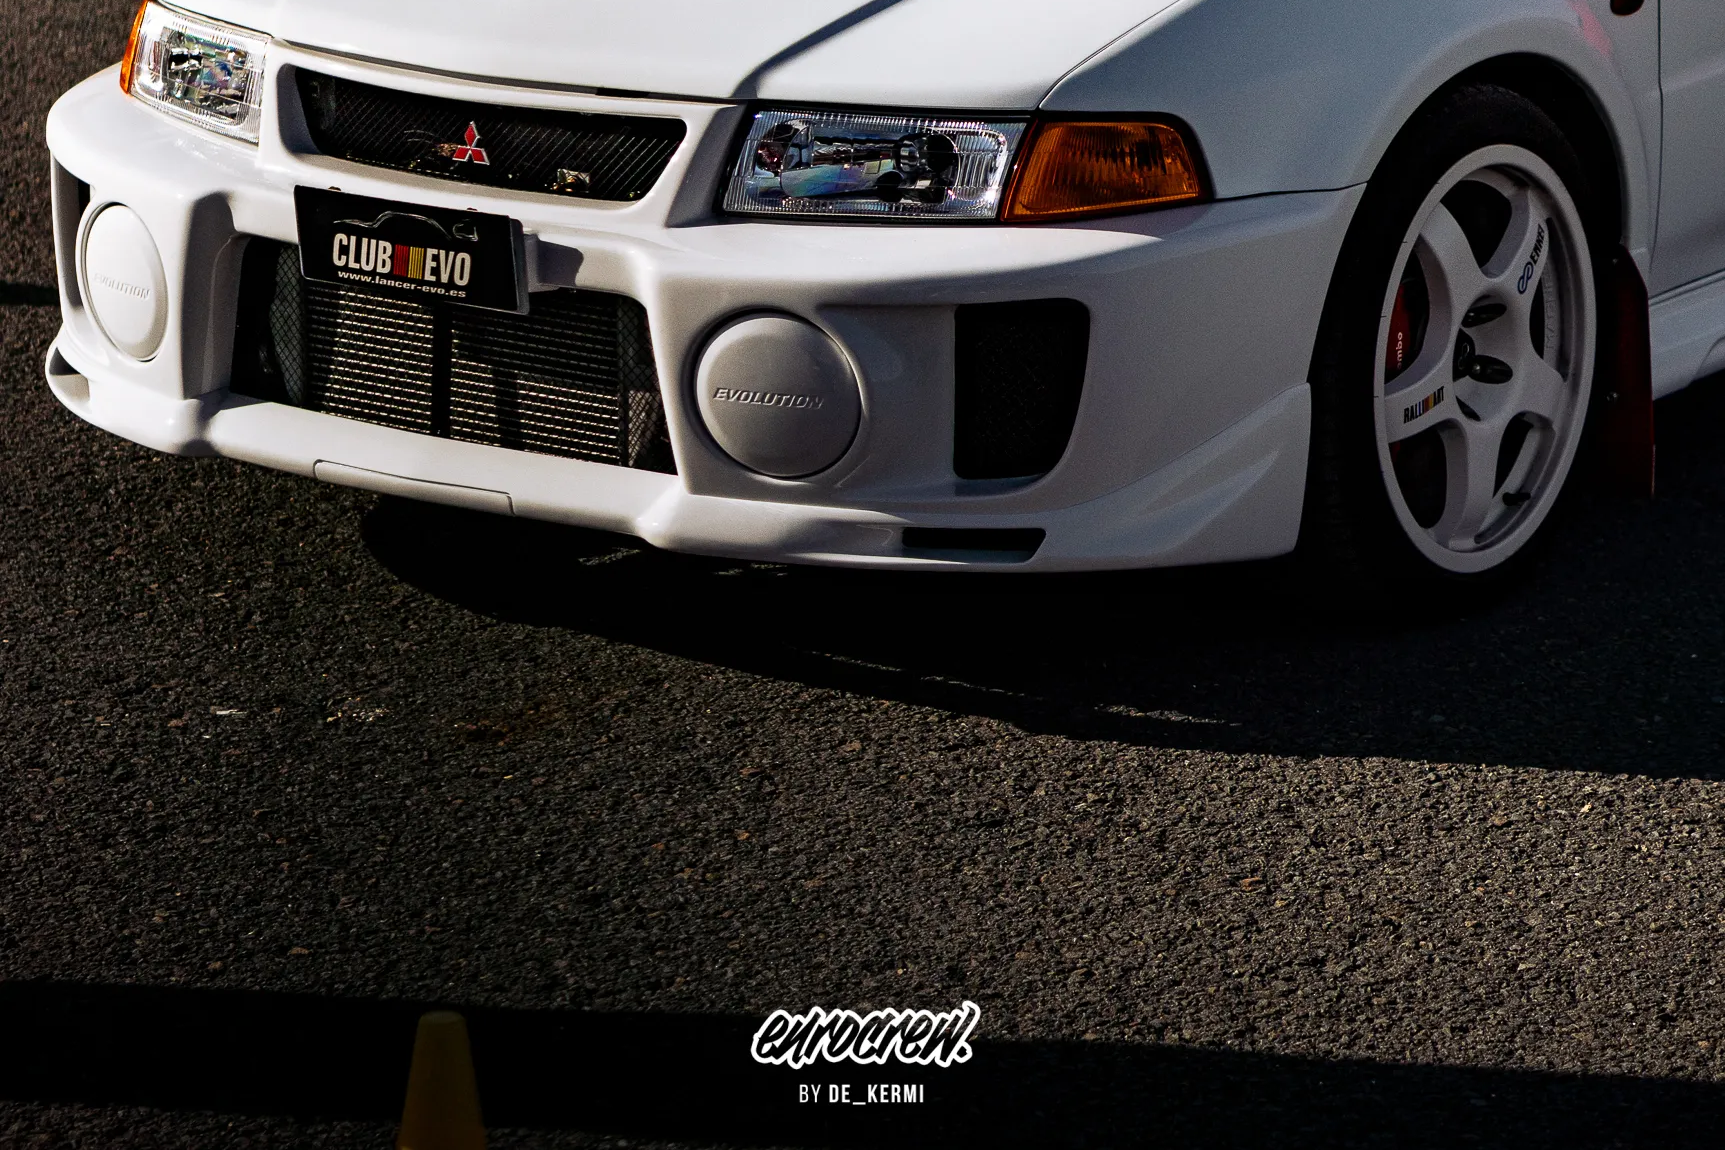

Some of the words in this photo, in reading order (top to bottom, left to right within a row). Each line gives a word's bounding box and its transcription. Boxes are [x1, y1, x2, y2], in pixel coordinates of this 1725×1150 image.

[1529, 223, 1545, 265] ENKEI
[332, 233, 393, 274] CLUB
[424, 247, 472, 287] EVO
[93, 273, 151, 301] EVOLUTION
[337, 270, 467, 298] www.lancer-evo.es
[712, 387, 825, 410] EVOLUTION
